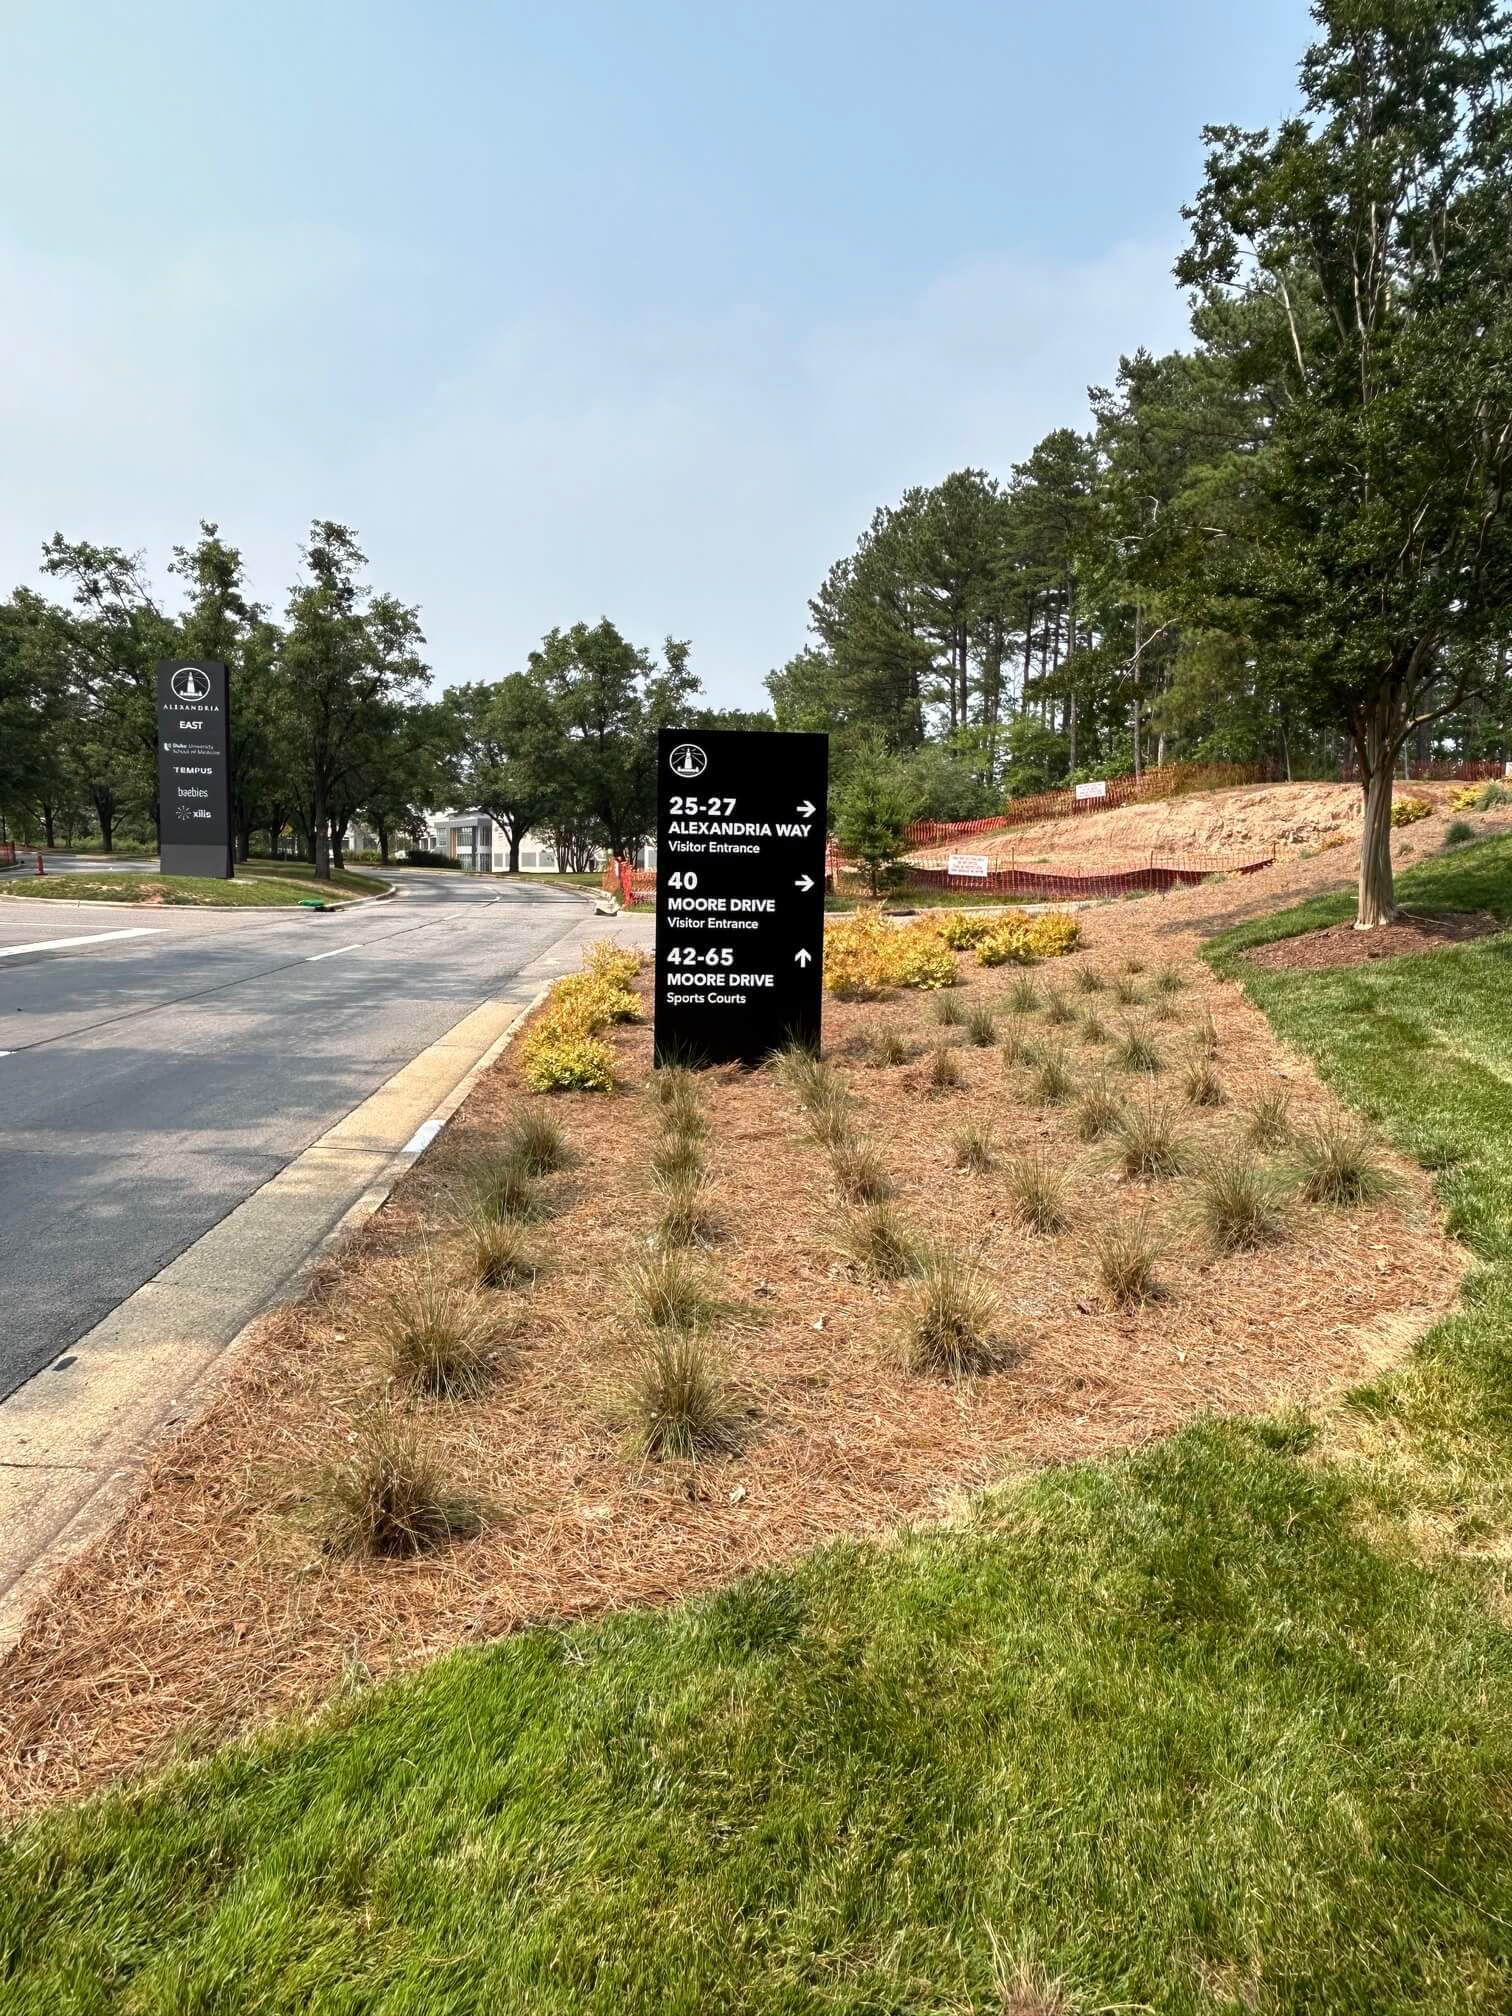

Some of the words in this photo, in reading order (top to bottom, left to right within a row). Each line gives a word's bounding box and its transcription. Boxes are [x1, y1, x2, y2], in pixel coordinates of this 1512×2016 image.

[163, 703, 220, 712] ALEXANDRIA
[179, 720, 204, 730] EAST
[173, 766, 213, 775] TEMPUS
[177, 786, 209, 798] baebies
[669, 796, 737, 816] 25-27
[668, 820, 772, 837] ALEXANDRIA
[775, 823, 812, 838] WAY
[668, 840, 707, 853] Visitor
[708, 841, 761, 854] Entrance
[668, 872, 698, 891] 40
[668, 897, 727, 912] MOORE
[730, 898, 776, 913] DRIVE
[667, 916, 706, 929] Visitor
[707, 917, 759, 930] Entrance
[666, 947, 734, 967] 42-65
[667, 972, 726, 987] MOORE
[729, 973, 775, 988] DRIVE
[666, 991, 705, 1006] Sports
[707, 992, 747, 1005] Courts
